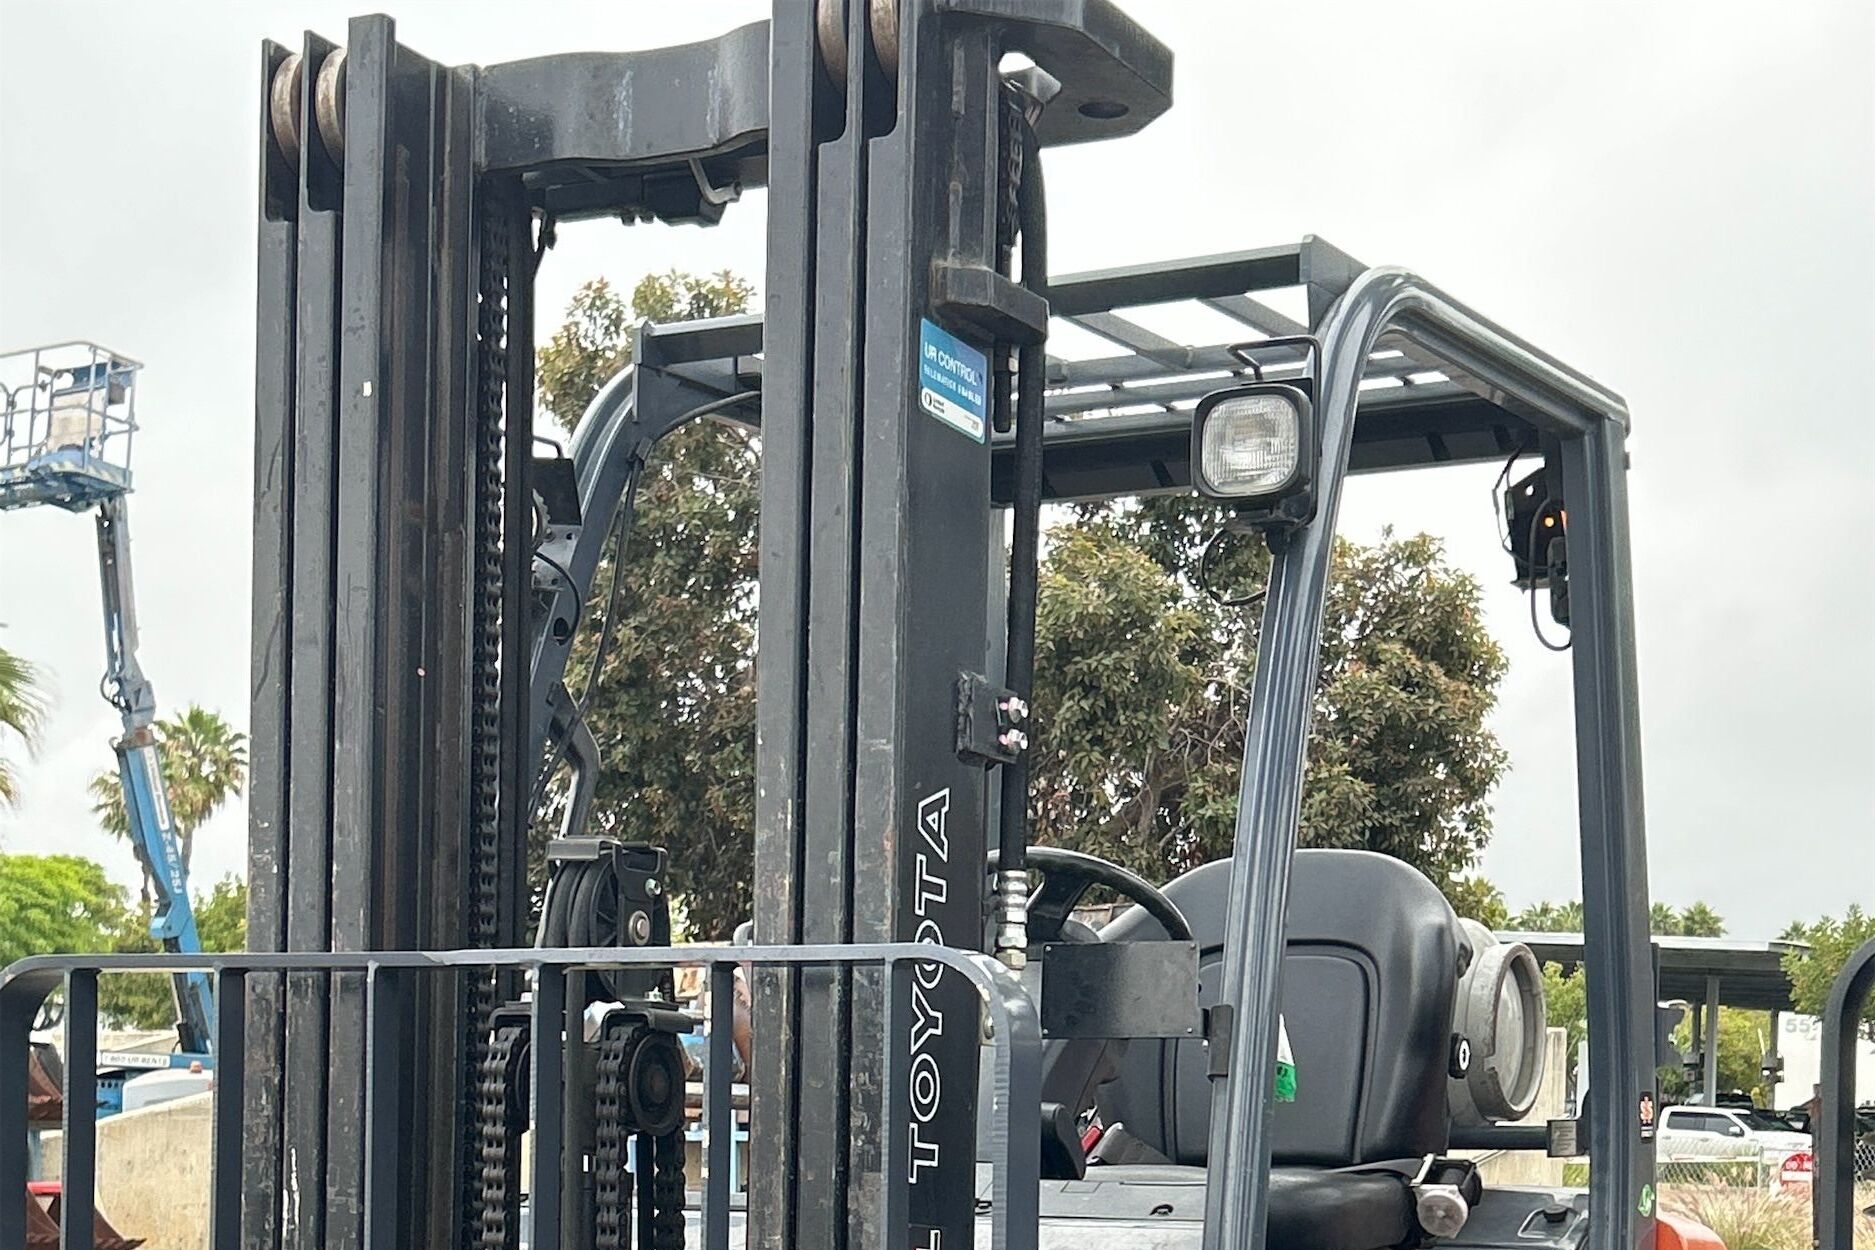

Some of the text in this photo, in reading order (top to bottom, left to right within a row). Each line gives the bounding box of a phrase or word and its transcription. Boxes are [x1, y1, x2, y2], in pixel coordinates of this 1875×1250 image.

[924, 341, 977, 386] UR CONTROL
[908, 787, 950, 1184] TOYOTA
